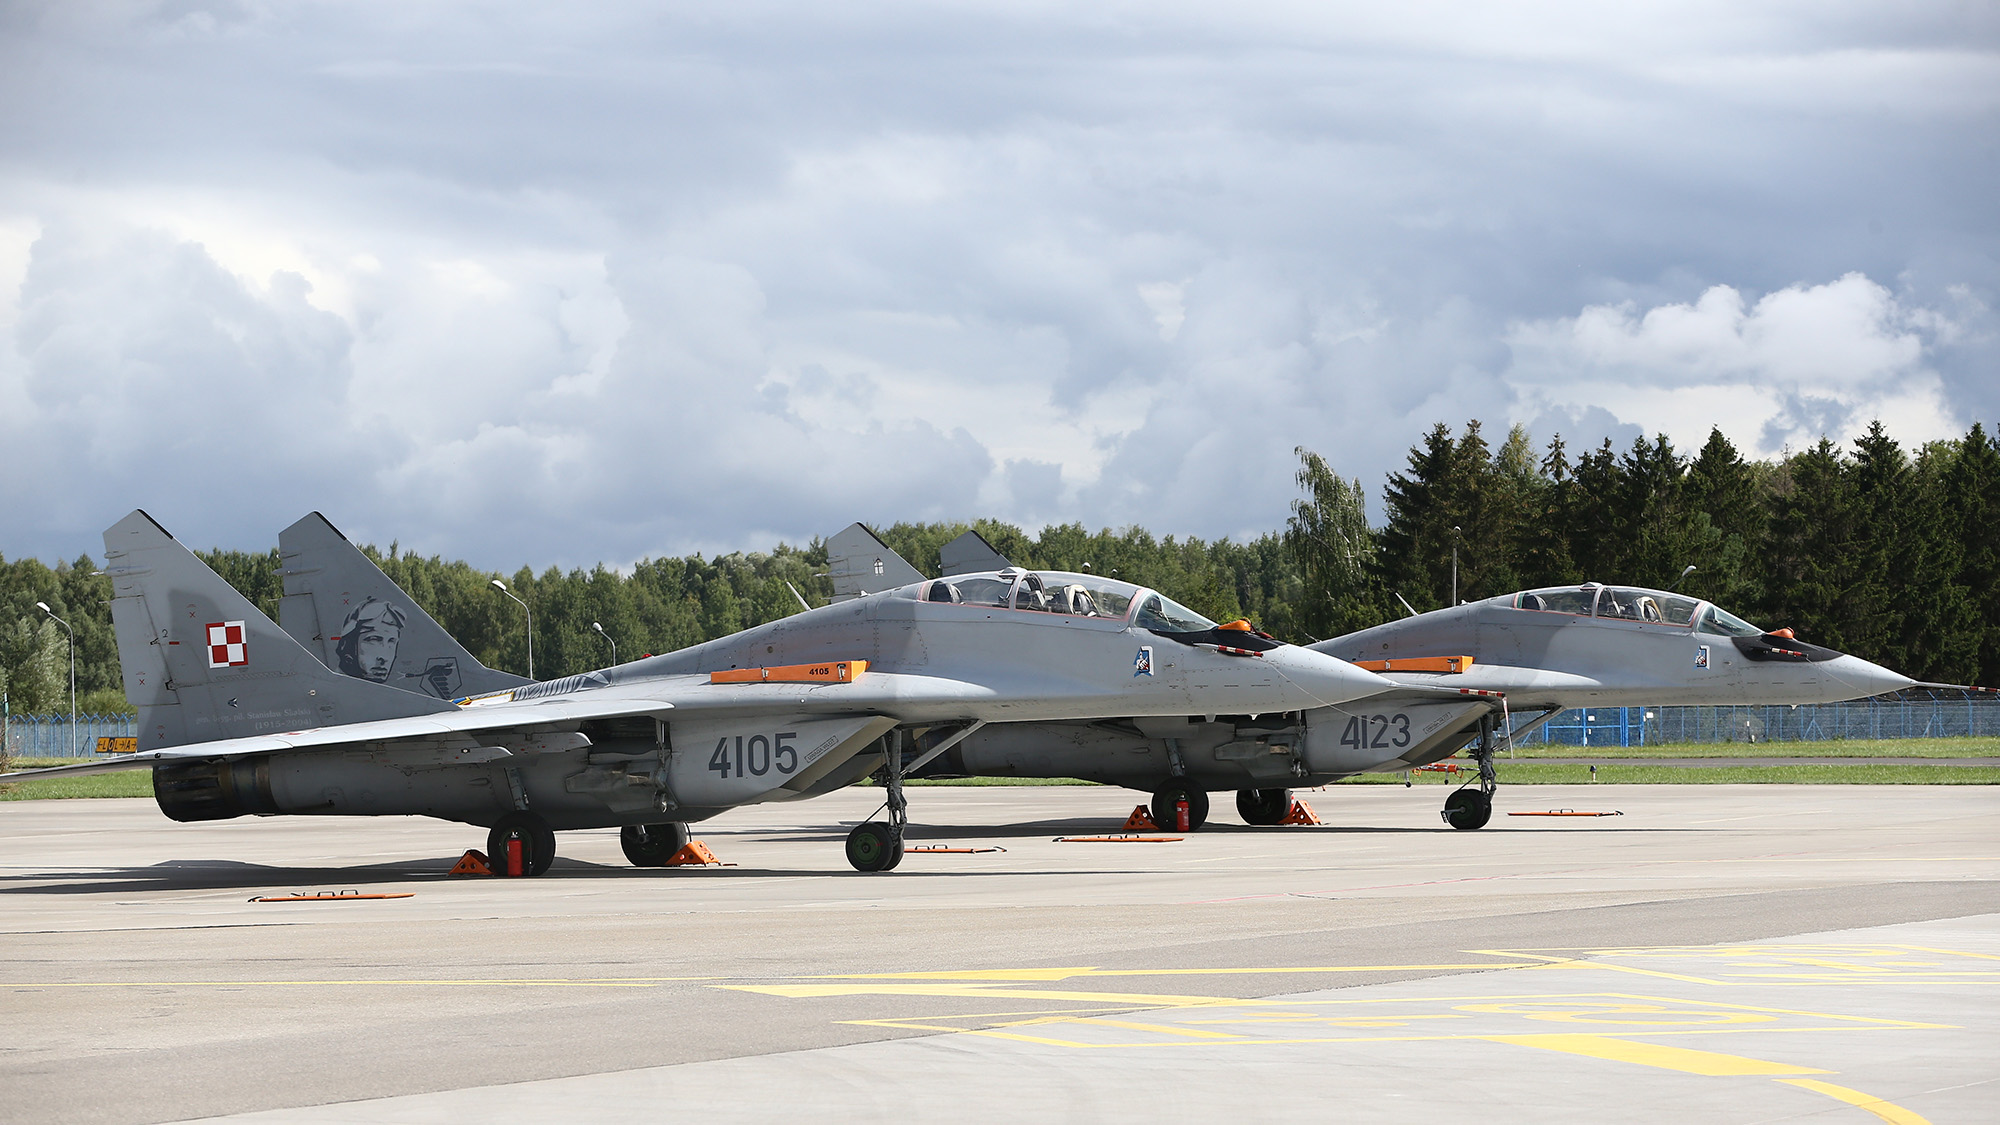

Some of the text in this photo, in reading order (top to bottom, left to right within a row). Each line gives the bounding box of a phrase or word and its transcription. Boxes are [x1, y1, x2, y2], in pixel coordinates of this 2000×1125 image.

[809, 667, 830, 676] 4105
[1340, 713, 1411, 750] 4123
[708, 732, 798, 779] 4105
